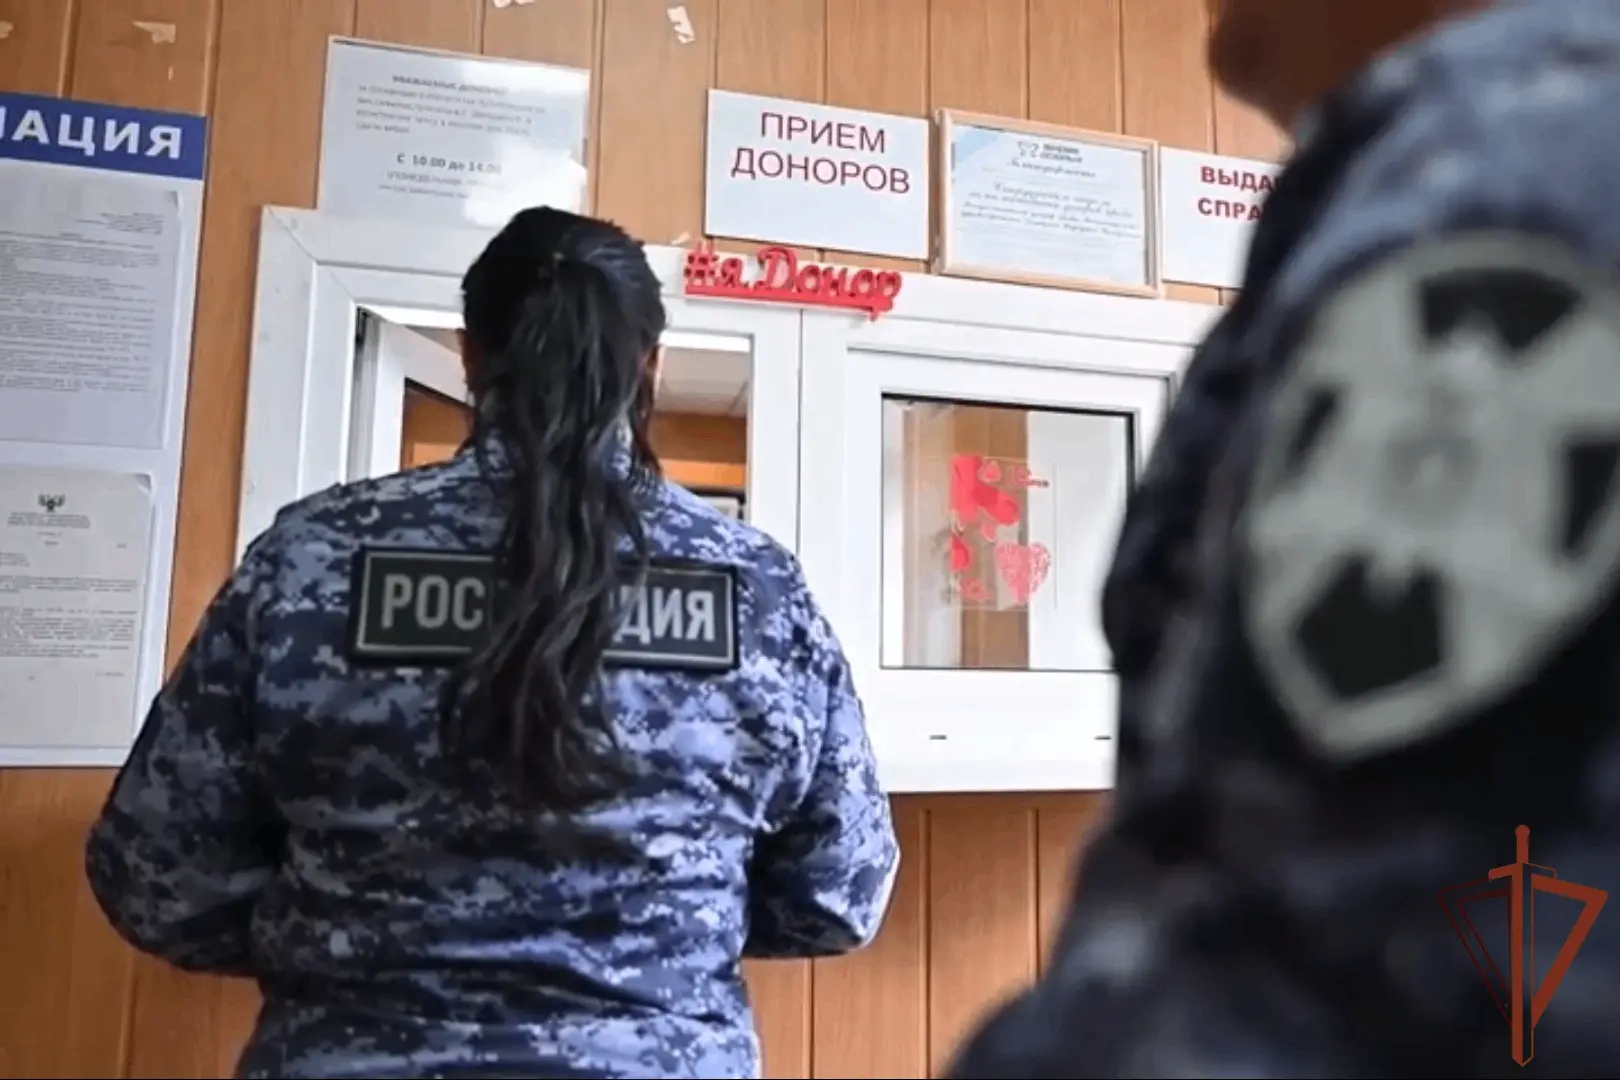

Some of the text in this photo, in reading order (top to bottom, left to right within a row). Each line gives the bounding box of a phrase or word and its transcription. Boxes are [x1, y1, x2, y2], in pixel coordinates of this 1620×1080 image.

[761, 111, 885, 153] ПРИЕМ
[731, 147, 910, 194] ДОНОРОВ
[1201, 166, 1279, 193] ВЫДА
[381, 573, 716, 645] РОСДИЯ
